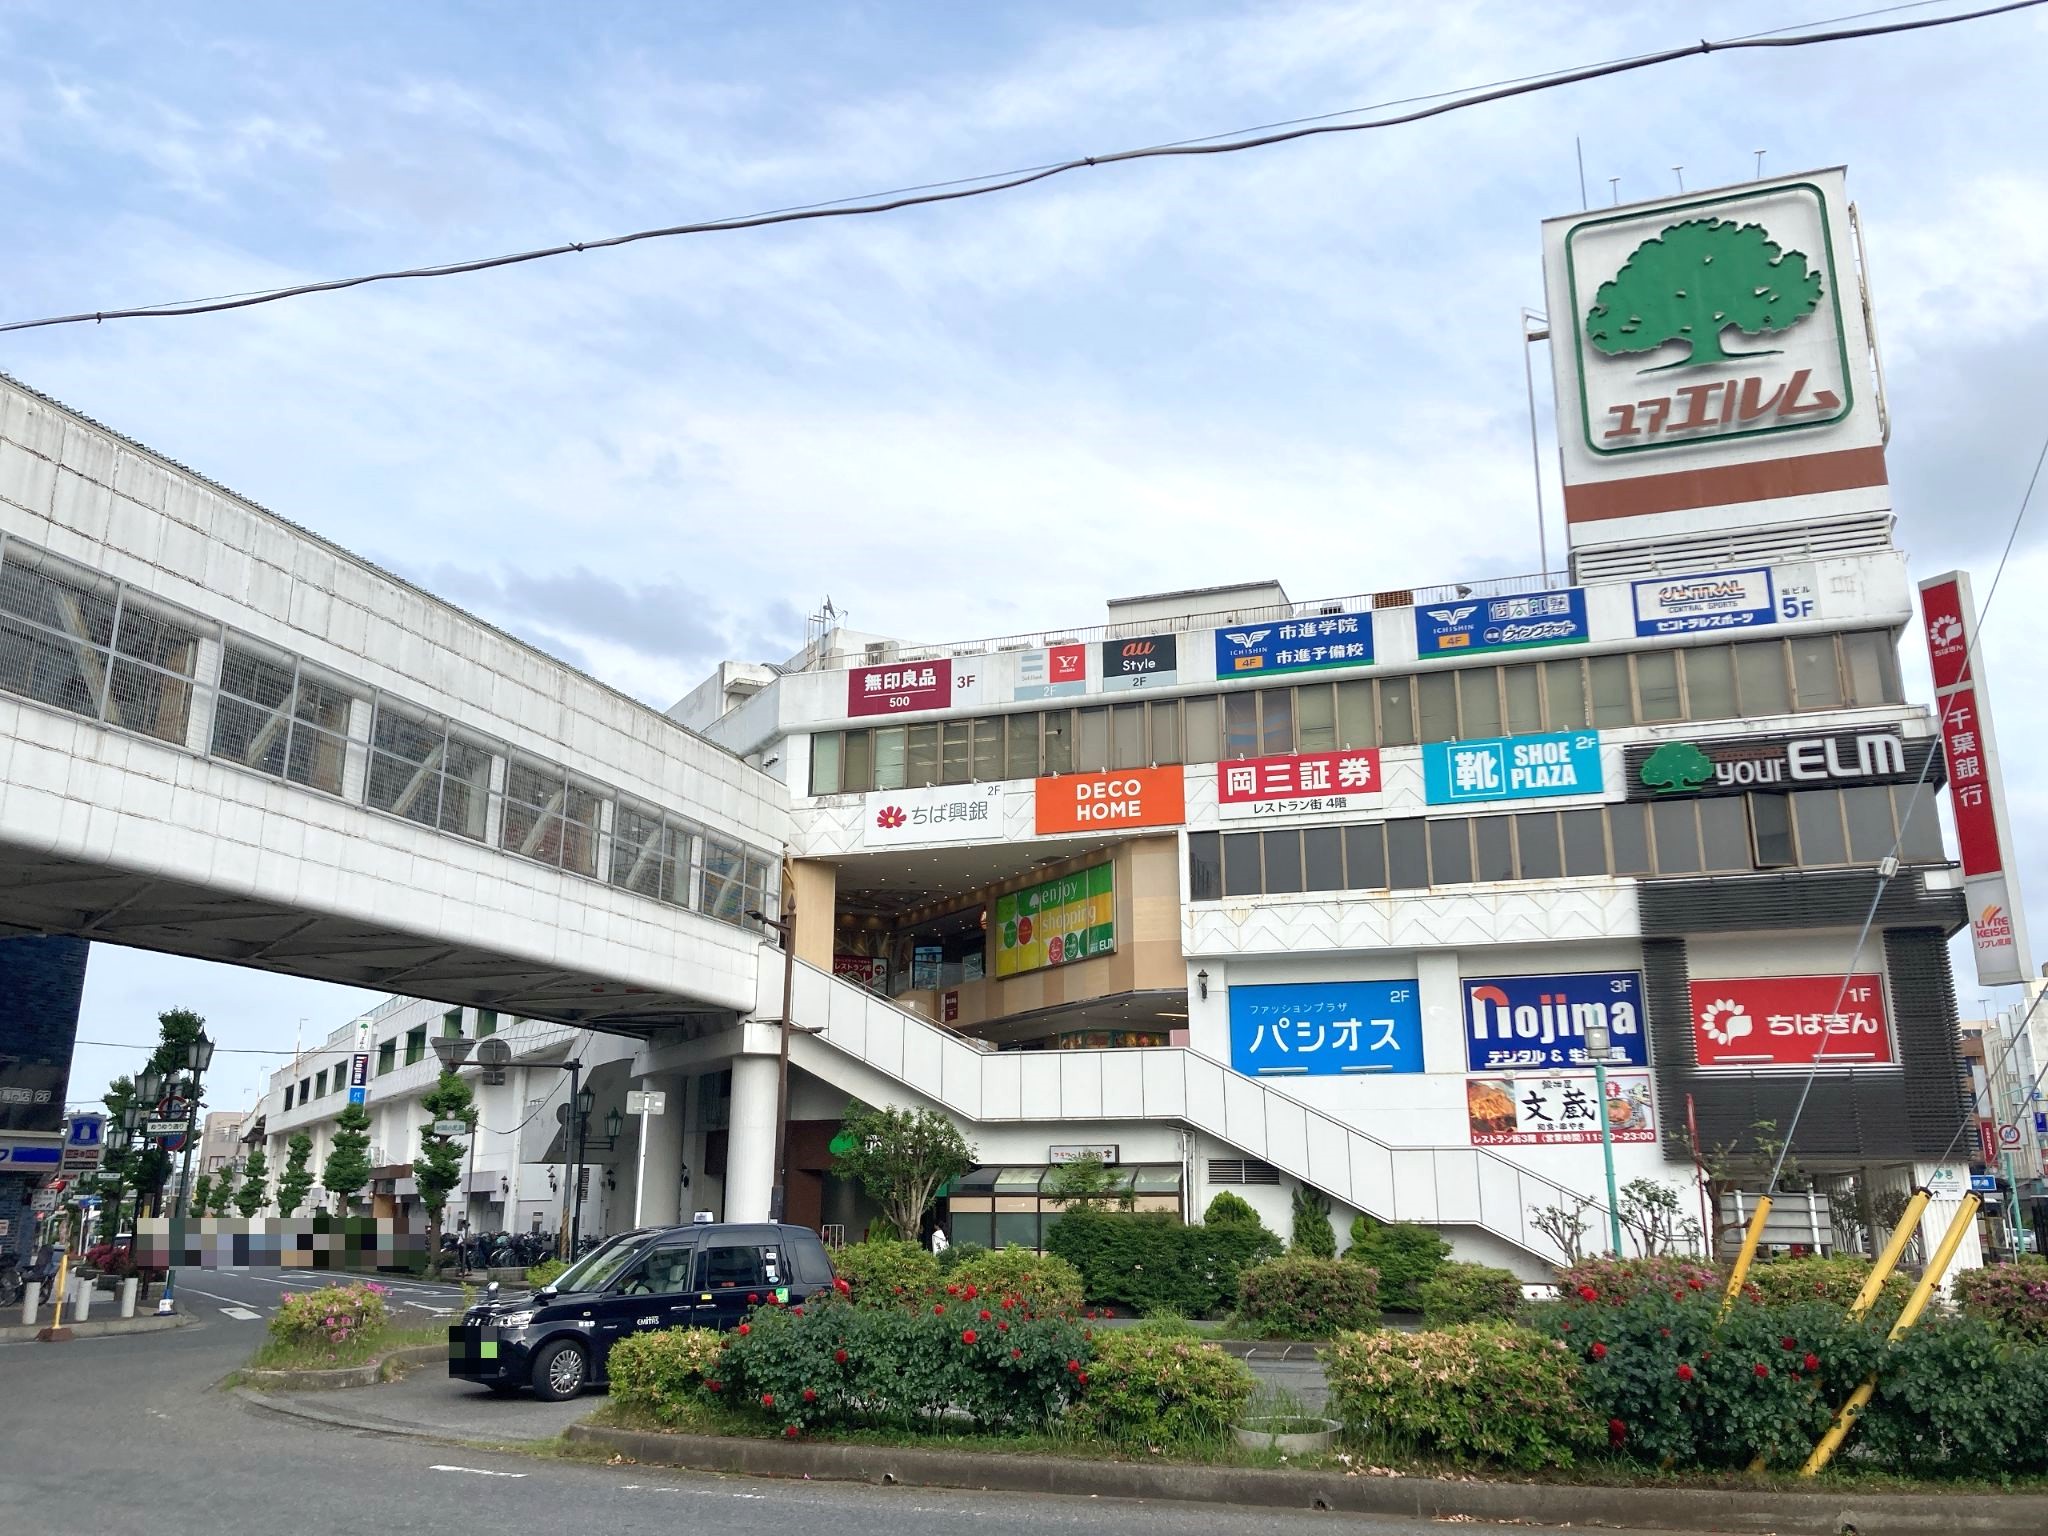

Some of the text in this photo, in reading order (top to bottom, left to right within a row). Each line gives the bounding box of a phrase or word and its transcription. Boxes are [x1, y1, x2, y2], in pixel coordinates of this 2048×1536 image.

[1604, 369, 1841, 439] ユアエルム
[1669, 601, 1738, 613] CENTRAL SPORTS
[1783, 597, 1813, 618] 5F
[1279, 618, 1359, 640] 市進学院
[1433, 625, 1474, 634] ICHISHIN
[1657, 613, 1753, 631] セントラルスポーツ
[1122, 641, 1156, 657] au
[1446, 636, 1461, 645] 4F
[1230, 646, 1268, 656] ICHISHIN
[1276, 643, 1364, 664] 市進予備校
[1056, 656, 1078, 668] Y!
[1122, 658, 1156, 671] Style
[1242, 658, 1256, 668] 4F
[864, 669, 937, 692] 無印良品
[957, 675, 975, 689] 3F
[1132, 676, 1147, 687] 2F
[1043, 686, 1056, 697] 2F
[889, 696, 910, 708] 500
[1575, 736, 1597, 750] 2F
[1514, 742, 1570, 764] SHOE
[1948, 707, 1983, 807] 千葉銀行
[1227, 758, 1371, 796] 岡三証券
[1455, 751, 1499, 791] 靴
[1511, 764, 1577, 790] PLAZA
[987, 785, 1001, 796] 2F
[1077, 780, 1141, 801] DECO
[912, 801, 988, 825] ちば興銀
[1077, 801, 1141, 822] HOME
[1253, 796, 1347, 814] レストラン街 4階
[1042, 881, 1078, 903] enjoy
[1043, 905, 1096, 932] shopping
[1976, 927, 2011, 938] KEISEI
[1610, 980, 1632, 993] 3F
[1848, 987, 1871, 1002] 1F
[1390, 990, 1410, 1003] 2F
[1249, 1002, 1348, 1015] ファッションプラザ
[1471, 985, 1637, 1044] nojima
[1766, 1012, 1878, 1036] ちばぎん
[1250, 1017, 1400, 1053] パシオス
[1488, 1046, 1626, 1063] デジタル & 生電
[1520, 1089, 1598, 1122] 文蔵
